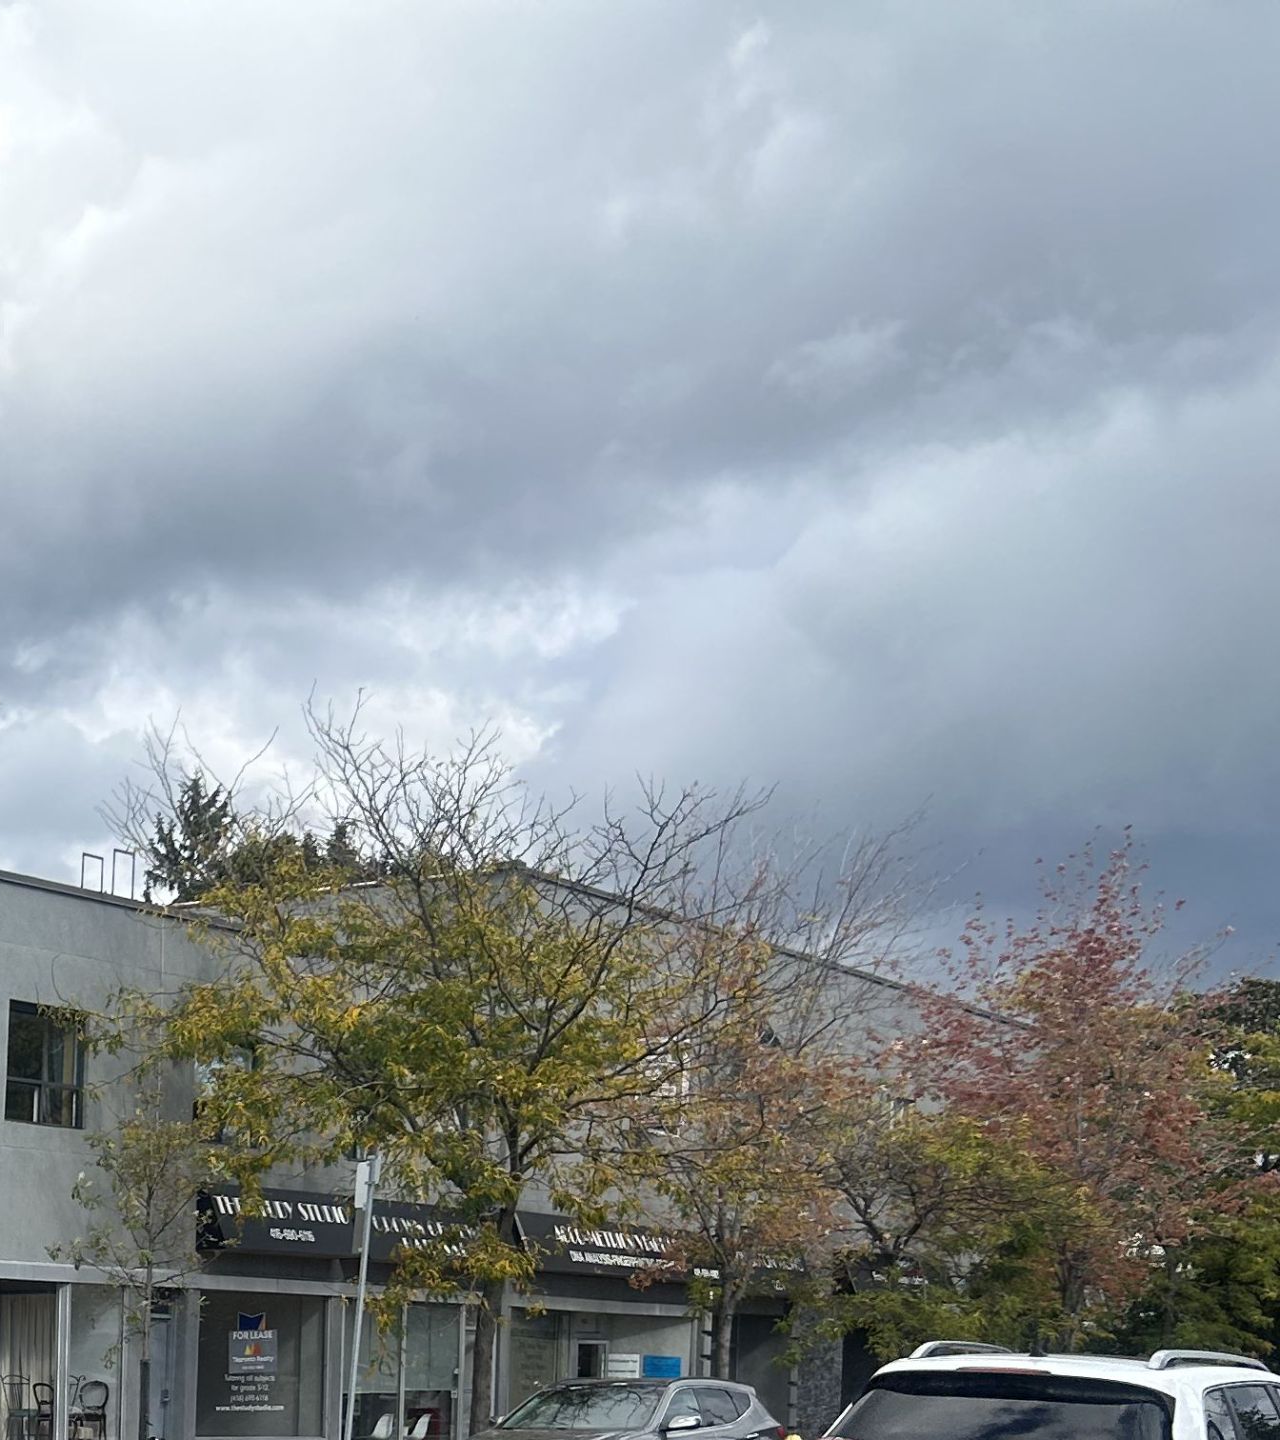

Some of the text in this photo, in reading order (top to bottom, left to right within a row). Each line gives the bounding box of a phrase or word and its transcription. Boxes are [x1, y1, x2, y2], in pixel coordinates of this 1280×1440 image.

[297, 1202, 350, 1225] STUDIO
[233, 1331, 273, 1340] FOR LEASE
